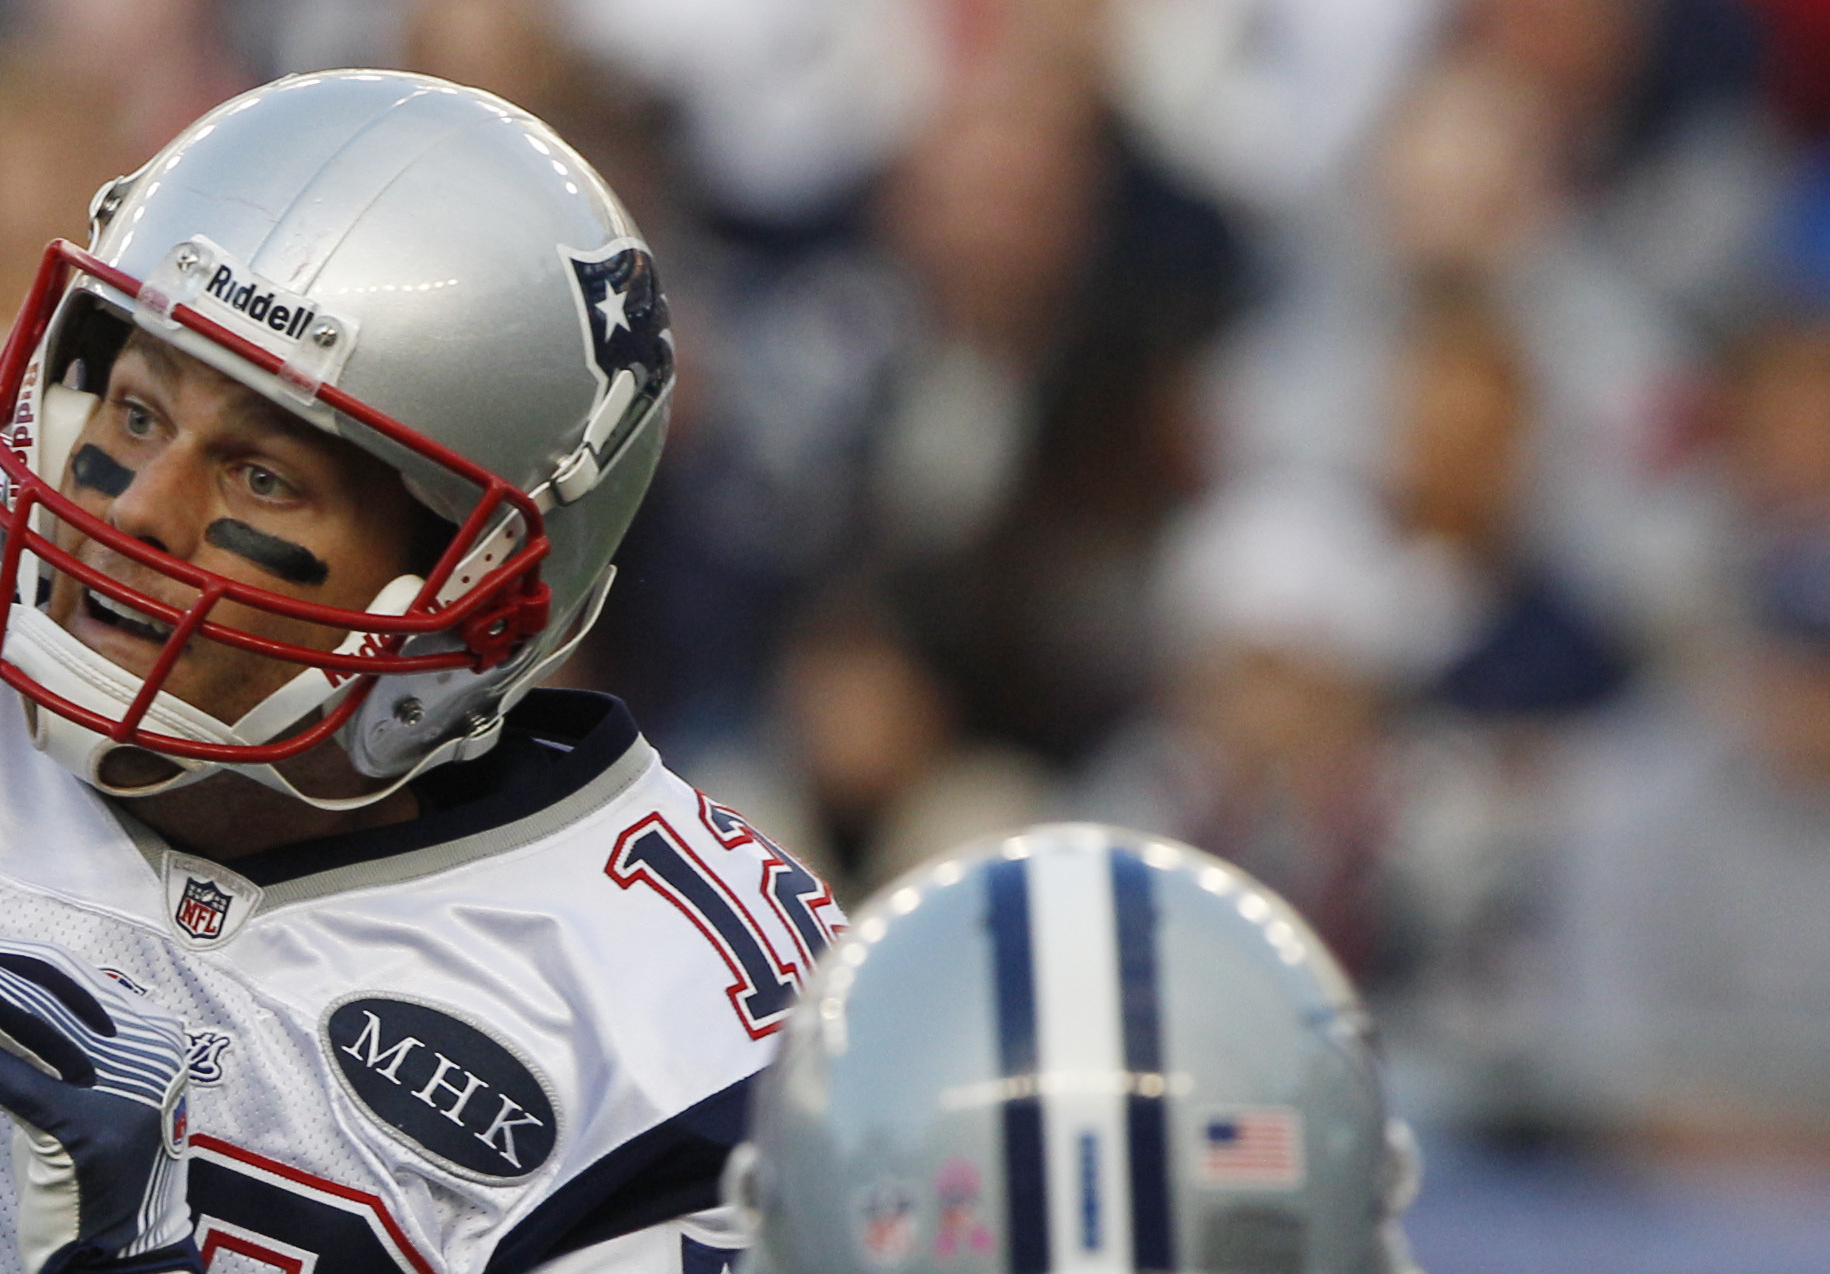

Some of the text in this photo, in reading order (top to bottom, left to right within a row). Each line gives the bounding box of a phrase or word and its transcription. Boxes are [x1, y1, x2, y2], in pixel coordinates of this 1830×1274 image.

[206, 264, 315, 340] Riddell
[178, 897, 218, 934] NFL
[603, 788, 852, 1041] 12
[340, 1009, 545, 1169] MHK
